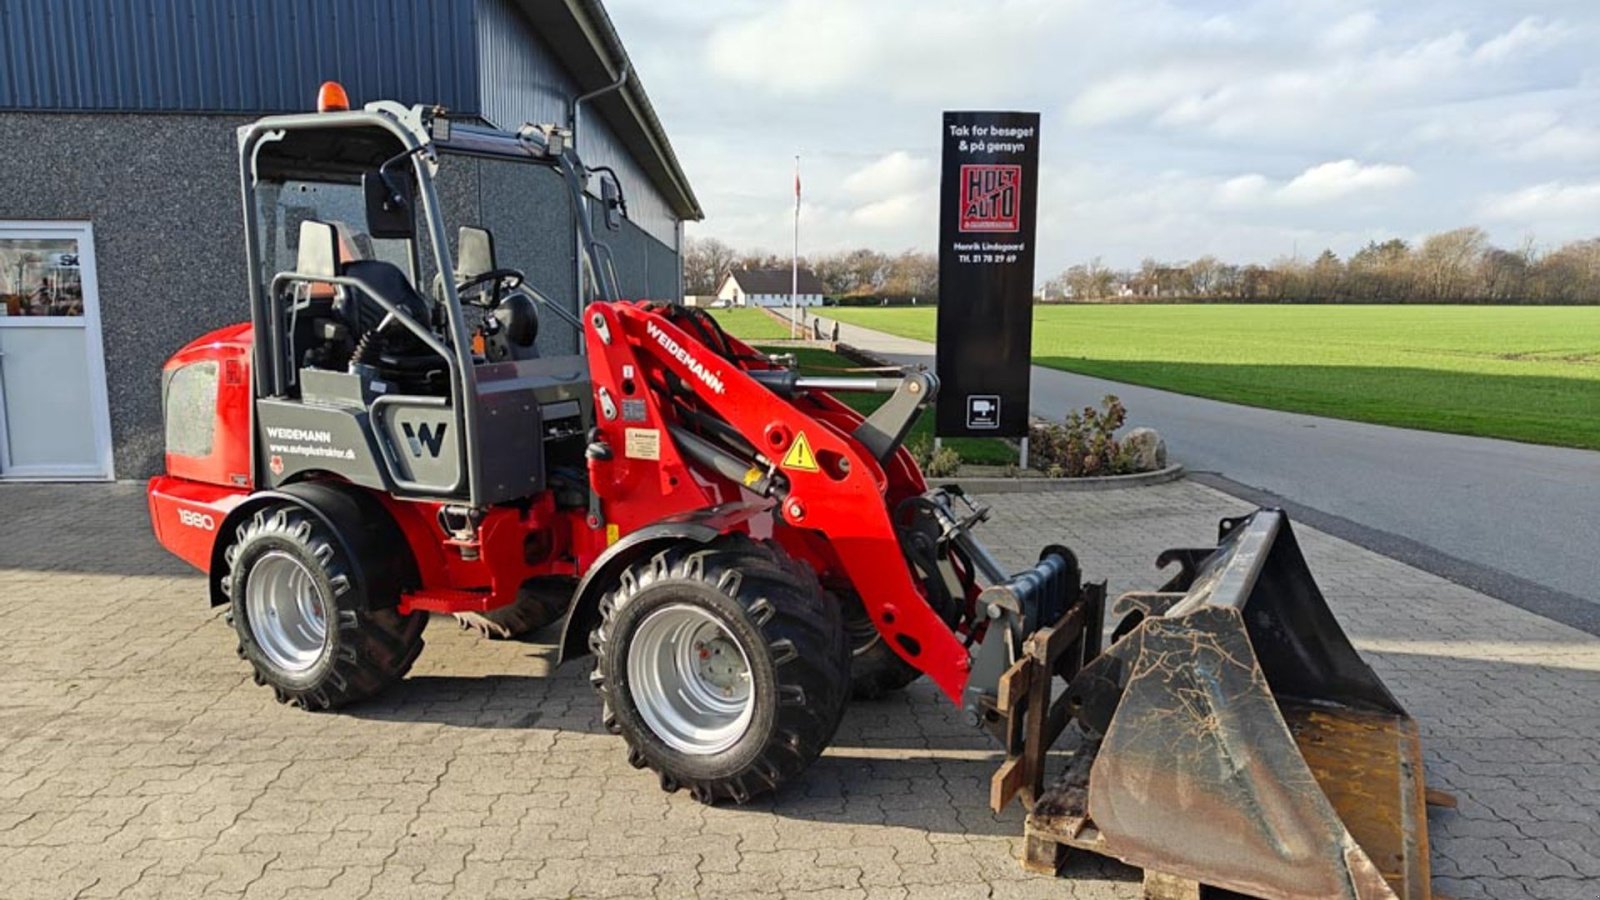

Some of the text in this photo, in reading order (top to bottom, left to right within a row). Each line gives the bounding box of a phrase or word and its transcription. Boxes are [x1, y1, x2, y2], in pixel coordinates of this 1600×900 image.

[950, 125, 1034, 139] Tak for besøget
[959, 140, 1025, 154] & på gensyn
[968, 170, 1015, 202] HOLT
[966, 185, 1014, 218] AUTO
[953, 242, 1025, 252] Henrik Lindegaard
[646, 320, 726, 395] WEIDEMANN
[266, 426, 332, 443] WEIDEMANN
